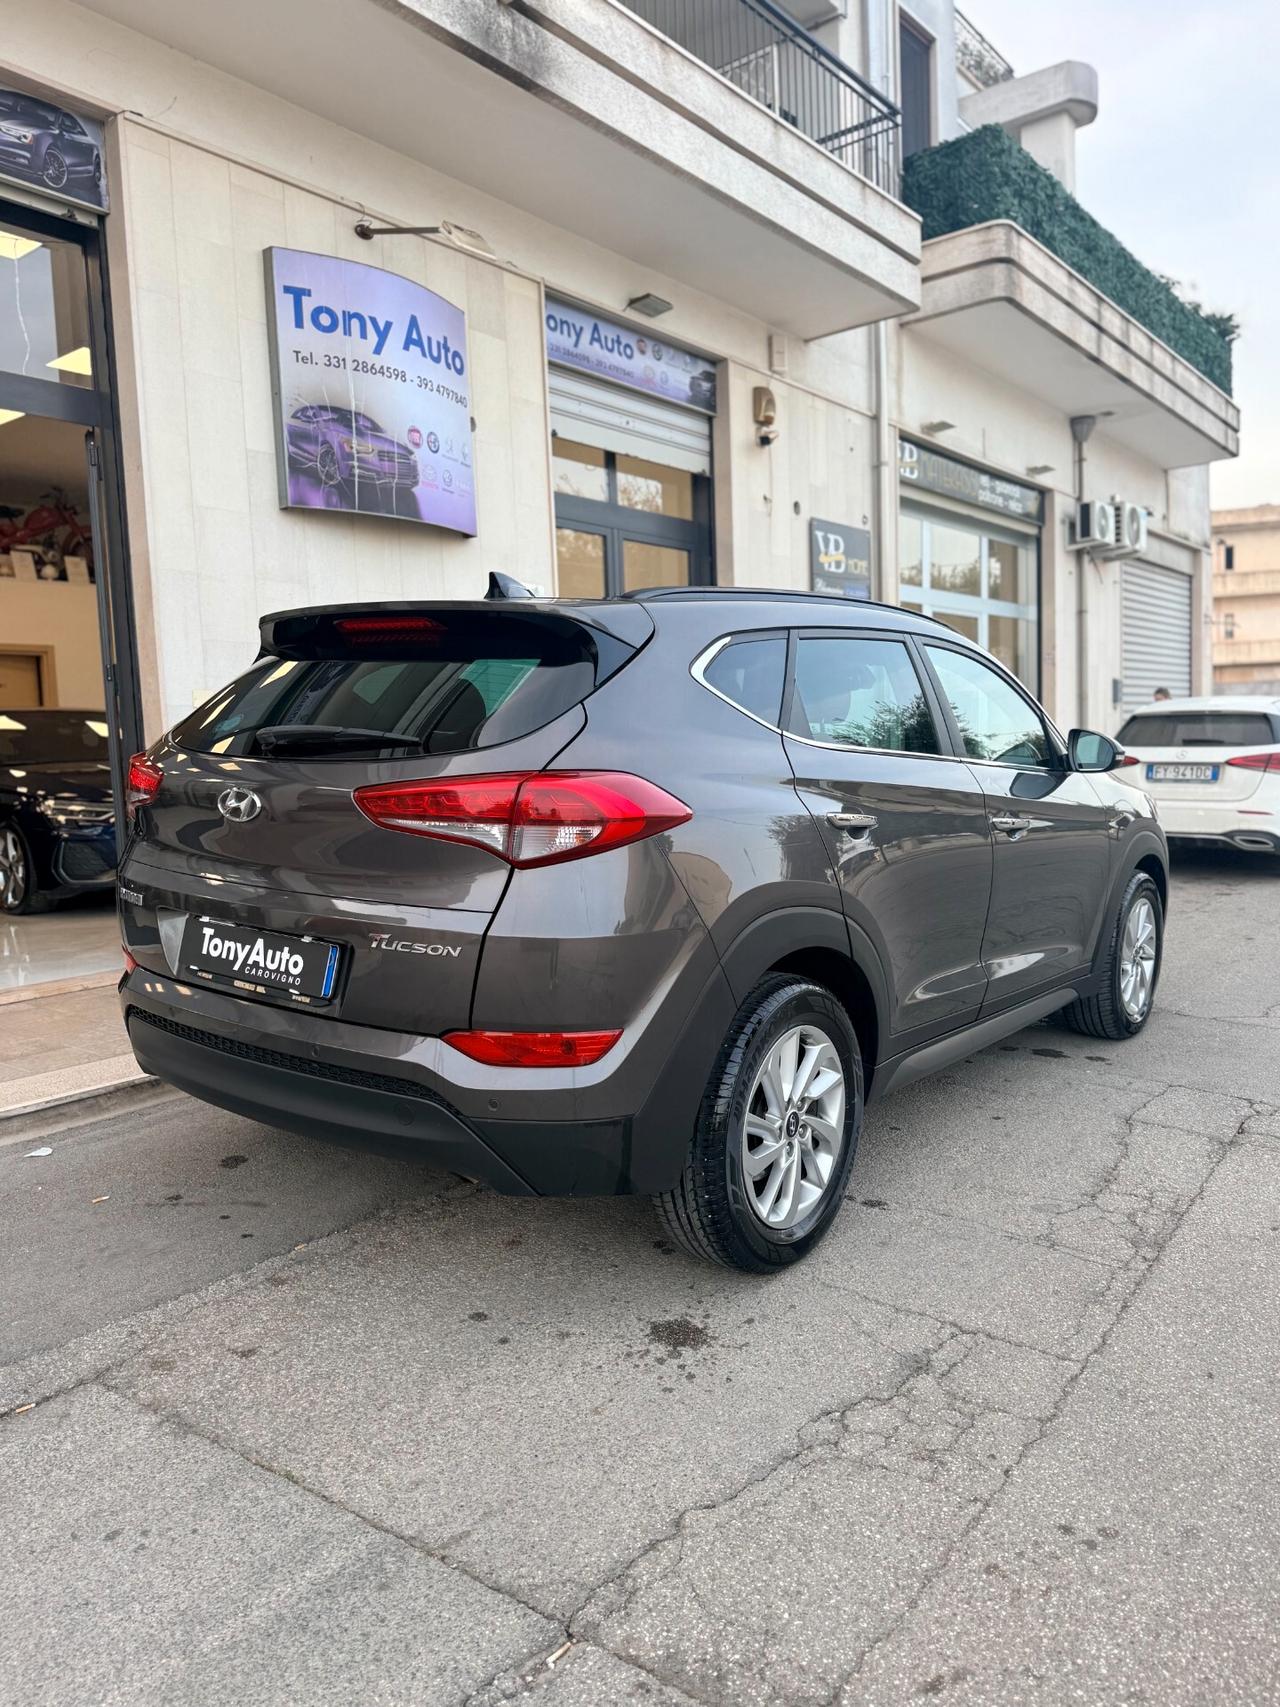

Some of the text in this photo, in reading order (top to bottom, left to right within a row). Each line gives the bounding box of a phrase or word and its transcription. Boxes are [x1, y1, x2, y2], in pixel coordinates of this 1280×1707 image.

[283, 285, 464, 376] Tony Auto
[545, 314, 634, 360] ony Auto
[293, 350, 318, 366] Tel.
[323, 354, 347, 370] 331
[352, 359, 407, 383] 2864598
[416, 376, 434, 393] 393
[201, 927, 304, 976] TonyAuto
[368, 933, 462, 958] TUCSON
[244, 966, 301, 986] CAROVIGNO
